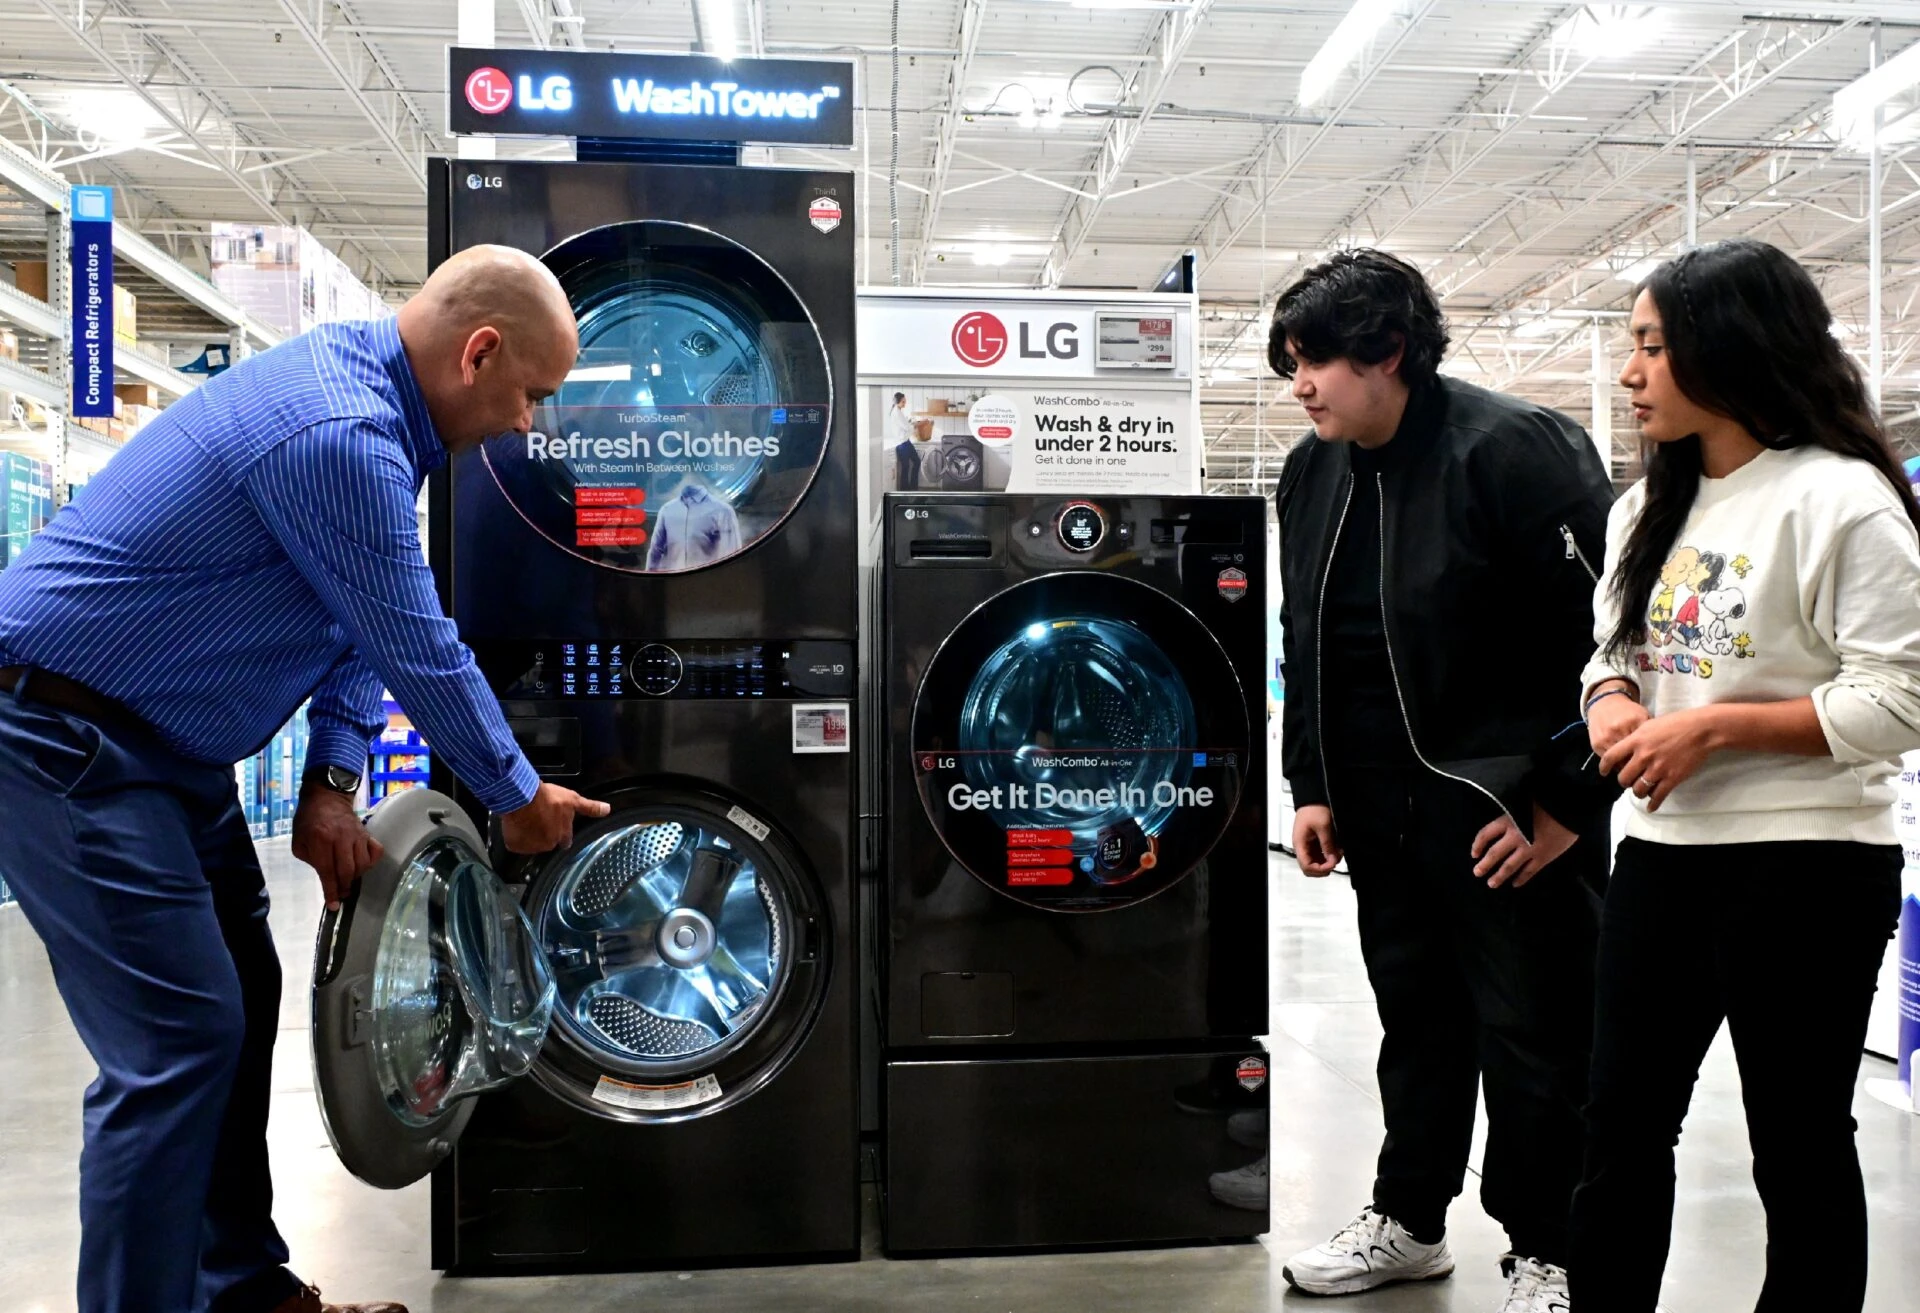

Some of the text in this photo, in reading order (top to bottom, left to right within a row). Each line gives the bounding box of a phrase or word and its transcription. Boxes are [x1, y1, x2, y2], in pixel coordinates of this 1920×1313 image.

[519, 75, 572, 110] LG
[484, 176, 503, 188] LG
[86, 243, 102, 405] Compact Refrigerators
[1019, 322, 1079, 360] LG
[1035, 414, 1174, 436] Wash & dry in
[528, 430, 780, 459] Refresh Clothes
[1036, 435, 1094, 452] under
[1099, 435, 1111, 452] 2
[574, 462, 735, 473] With Steam In Between Washes
[1035, 455, 1127, 466] Get it done in one
[917, 510, 929, 518] LG
[938, 758, 956, 769] LG
[948, 781, 1214, 811] Get It Done In One
[1104, 843, 1109, 851] 2
